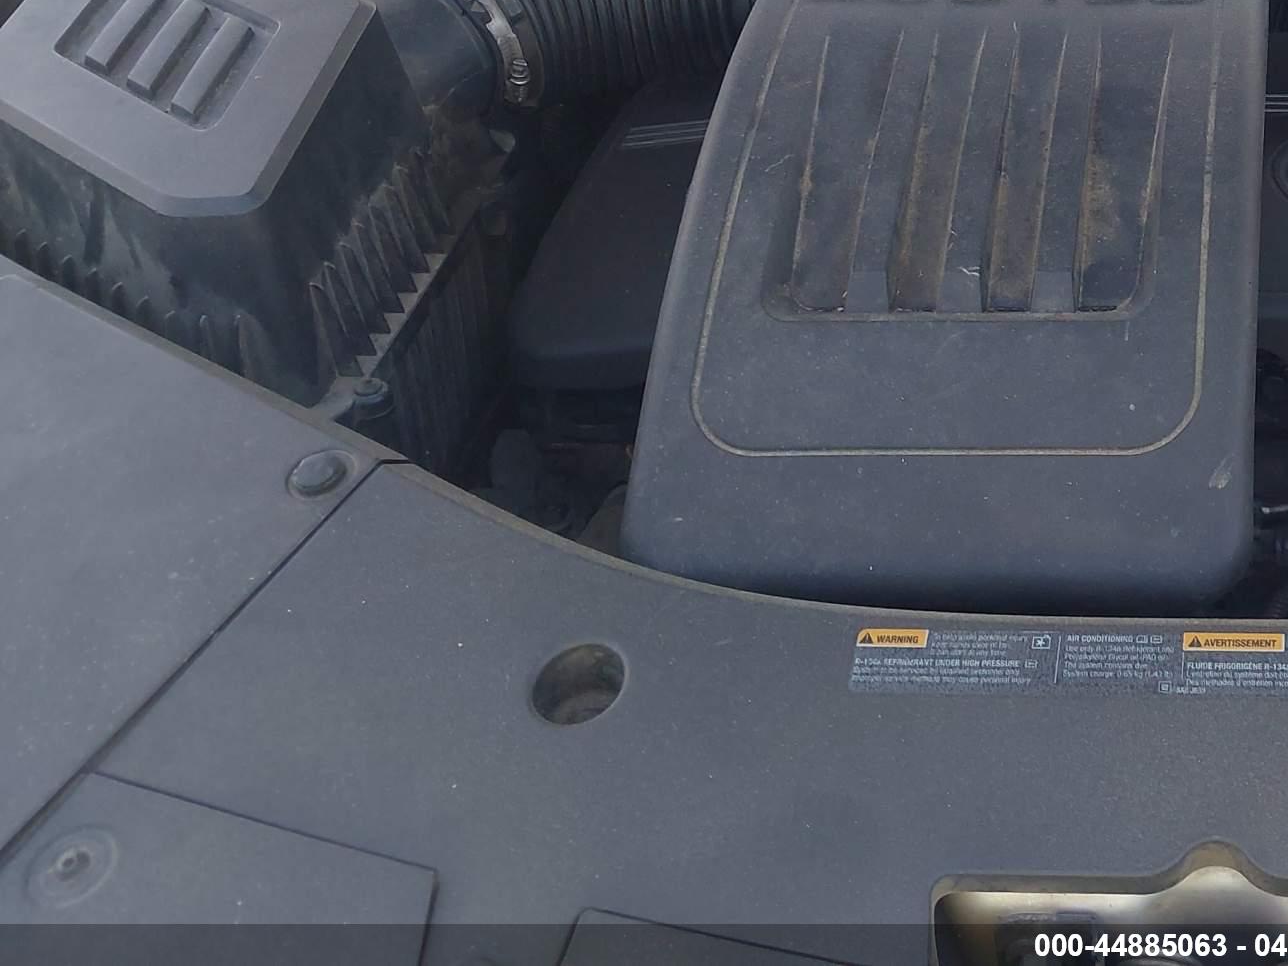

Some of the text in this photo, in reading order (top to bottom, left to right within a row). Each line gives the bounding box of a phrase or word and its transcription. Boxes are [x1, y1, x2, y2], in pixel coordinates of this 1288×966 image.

[877, 635, 919, 645] WARNING
[1067, 635, 1134, 643] AIR CONDITIONING
[1204, 639, 1277, 648] AVERTISSEMENT
[935, 659, 961, 667] UNDER
[981, 660, 1020, 668] PRESSURE
[1187, 662, 1212, 670] FLUIDE
